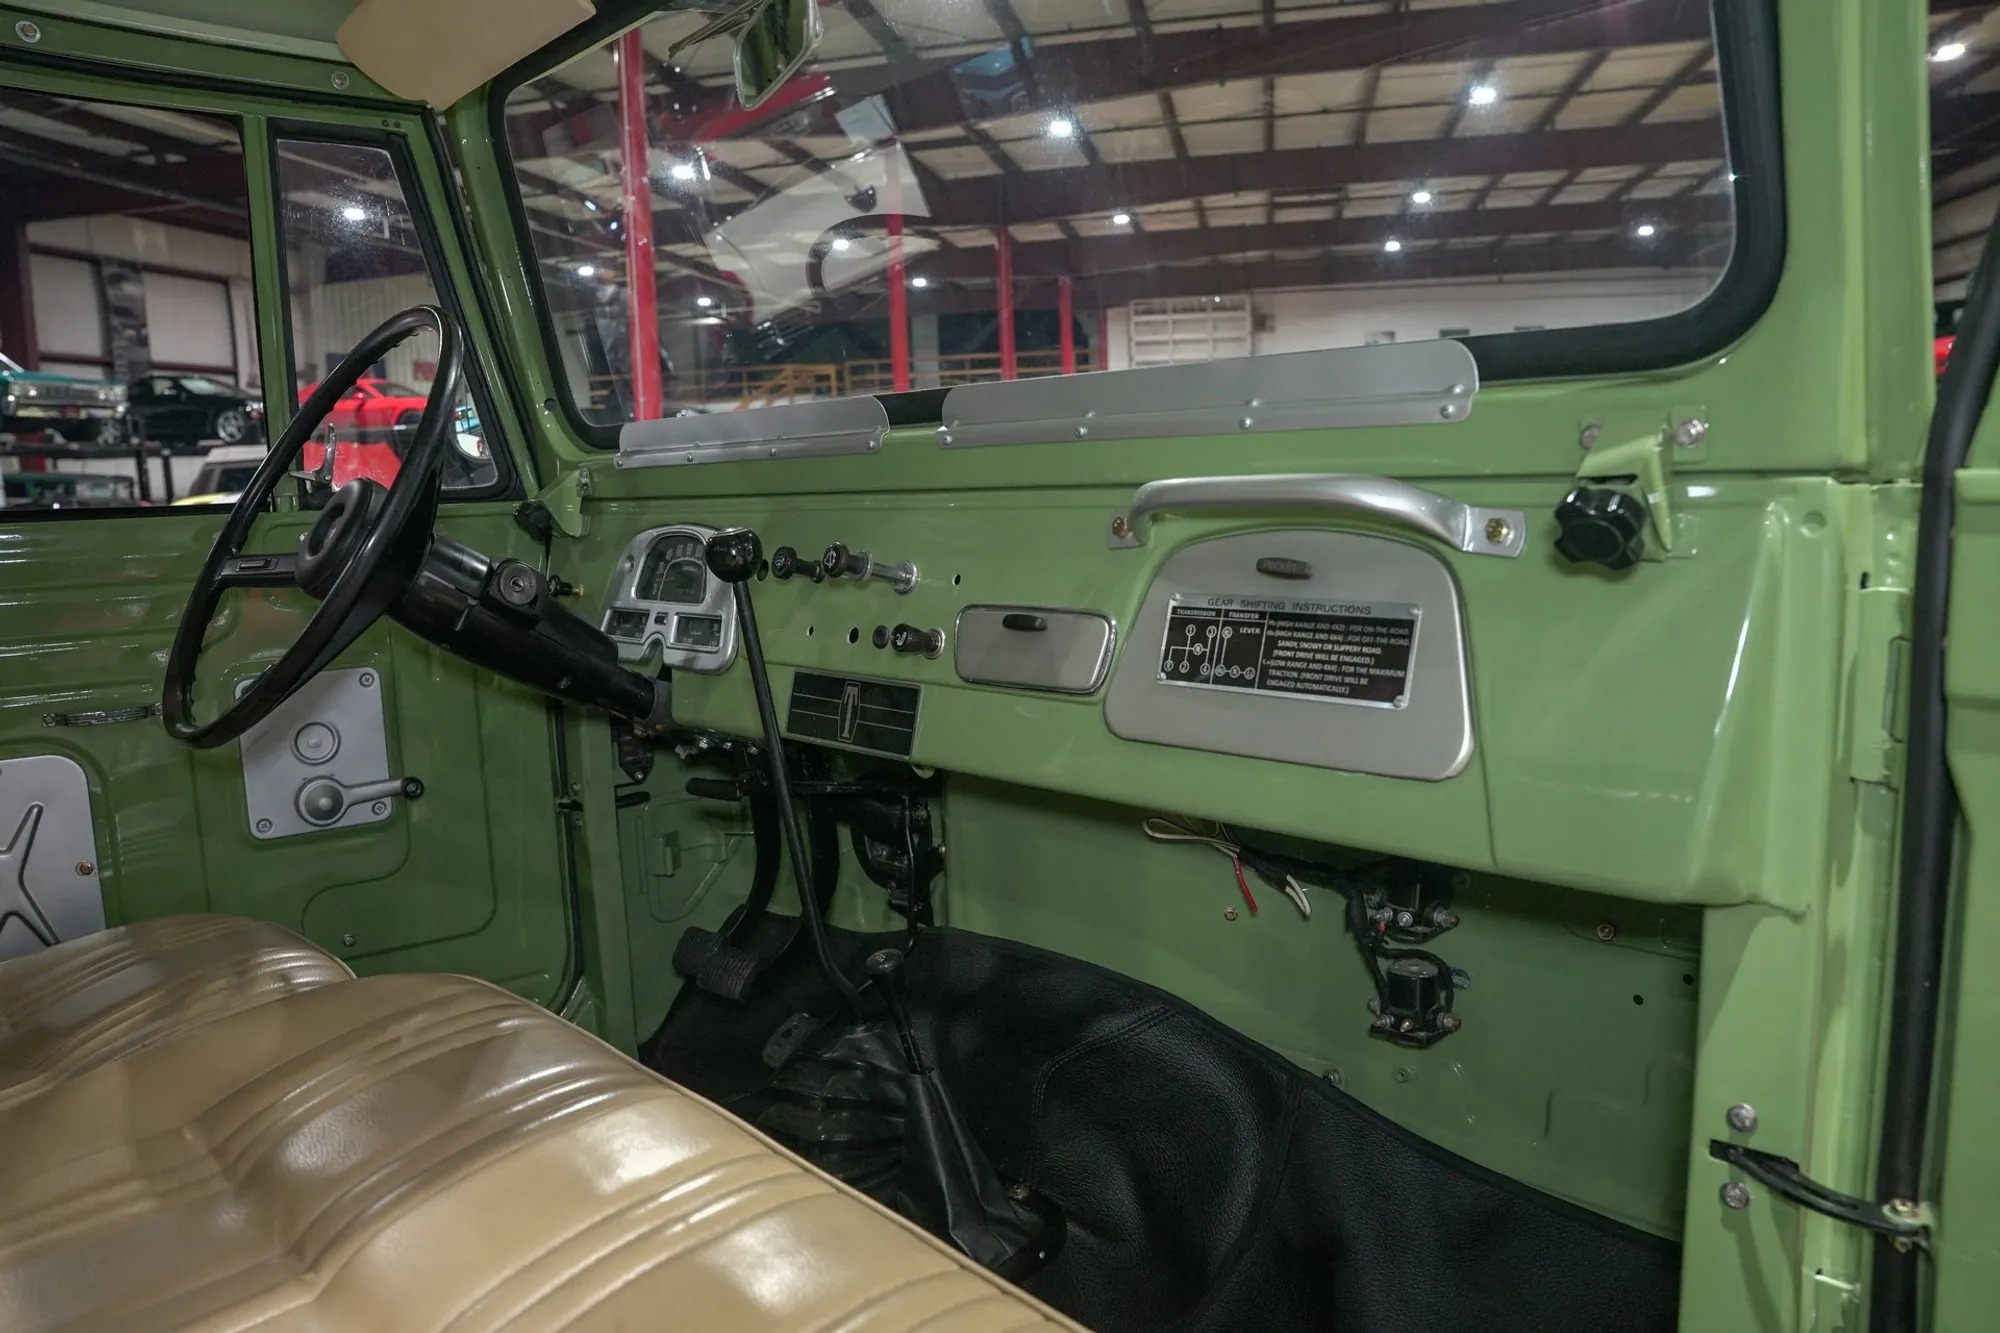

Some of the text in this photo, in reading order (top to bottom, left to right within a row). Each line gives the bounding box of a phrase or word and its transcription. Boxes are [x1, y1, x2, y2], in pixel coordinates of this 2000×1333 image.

[1208, 598, 1372, 615] GEAR SHIFTING INSTRUCTIONS
[1177, 608, 1216, 616] TRANSMISSION
[1240, 626, 1260, 634] LEVER
